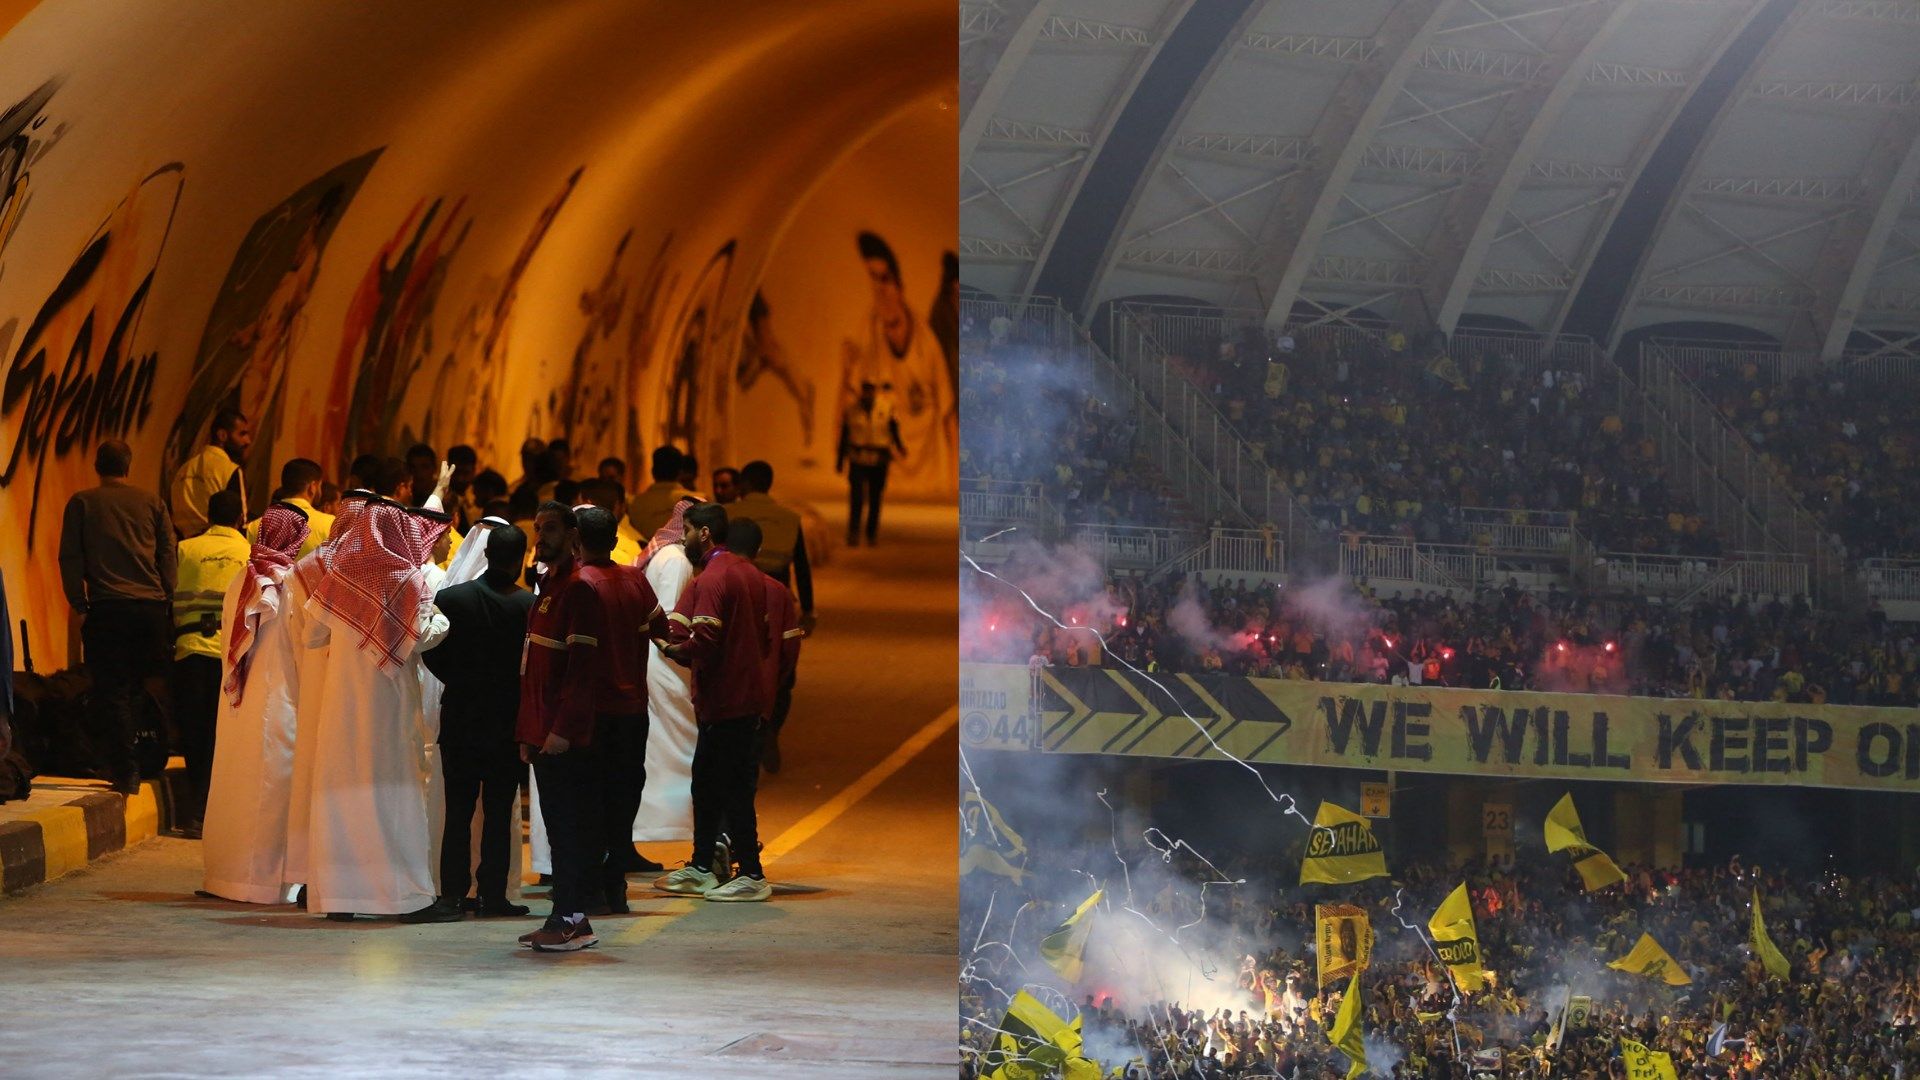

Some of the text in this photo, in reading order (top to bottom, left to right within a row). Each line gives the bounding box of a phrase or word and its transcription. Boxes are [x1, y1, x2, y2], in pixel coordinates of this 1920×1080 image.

[993, 714, 1029, 744] 44
[1317, 695, 1433, 762] WE
[1459, 704, 1631, 769] WILL
[1654, 710, 1833, 774] KEEP
[1486, 811, 1509, 830] 23
